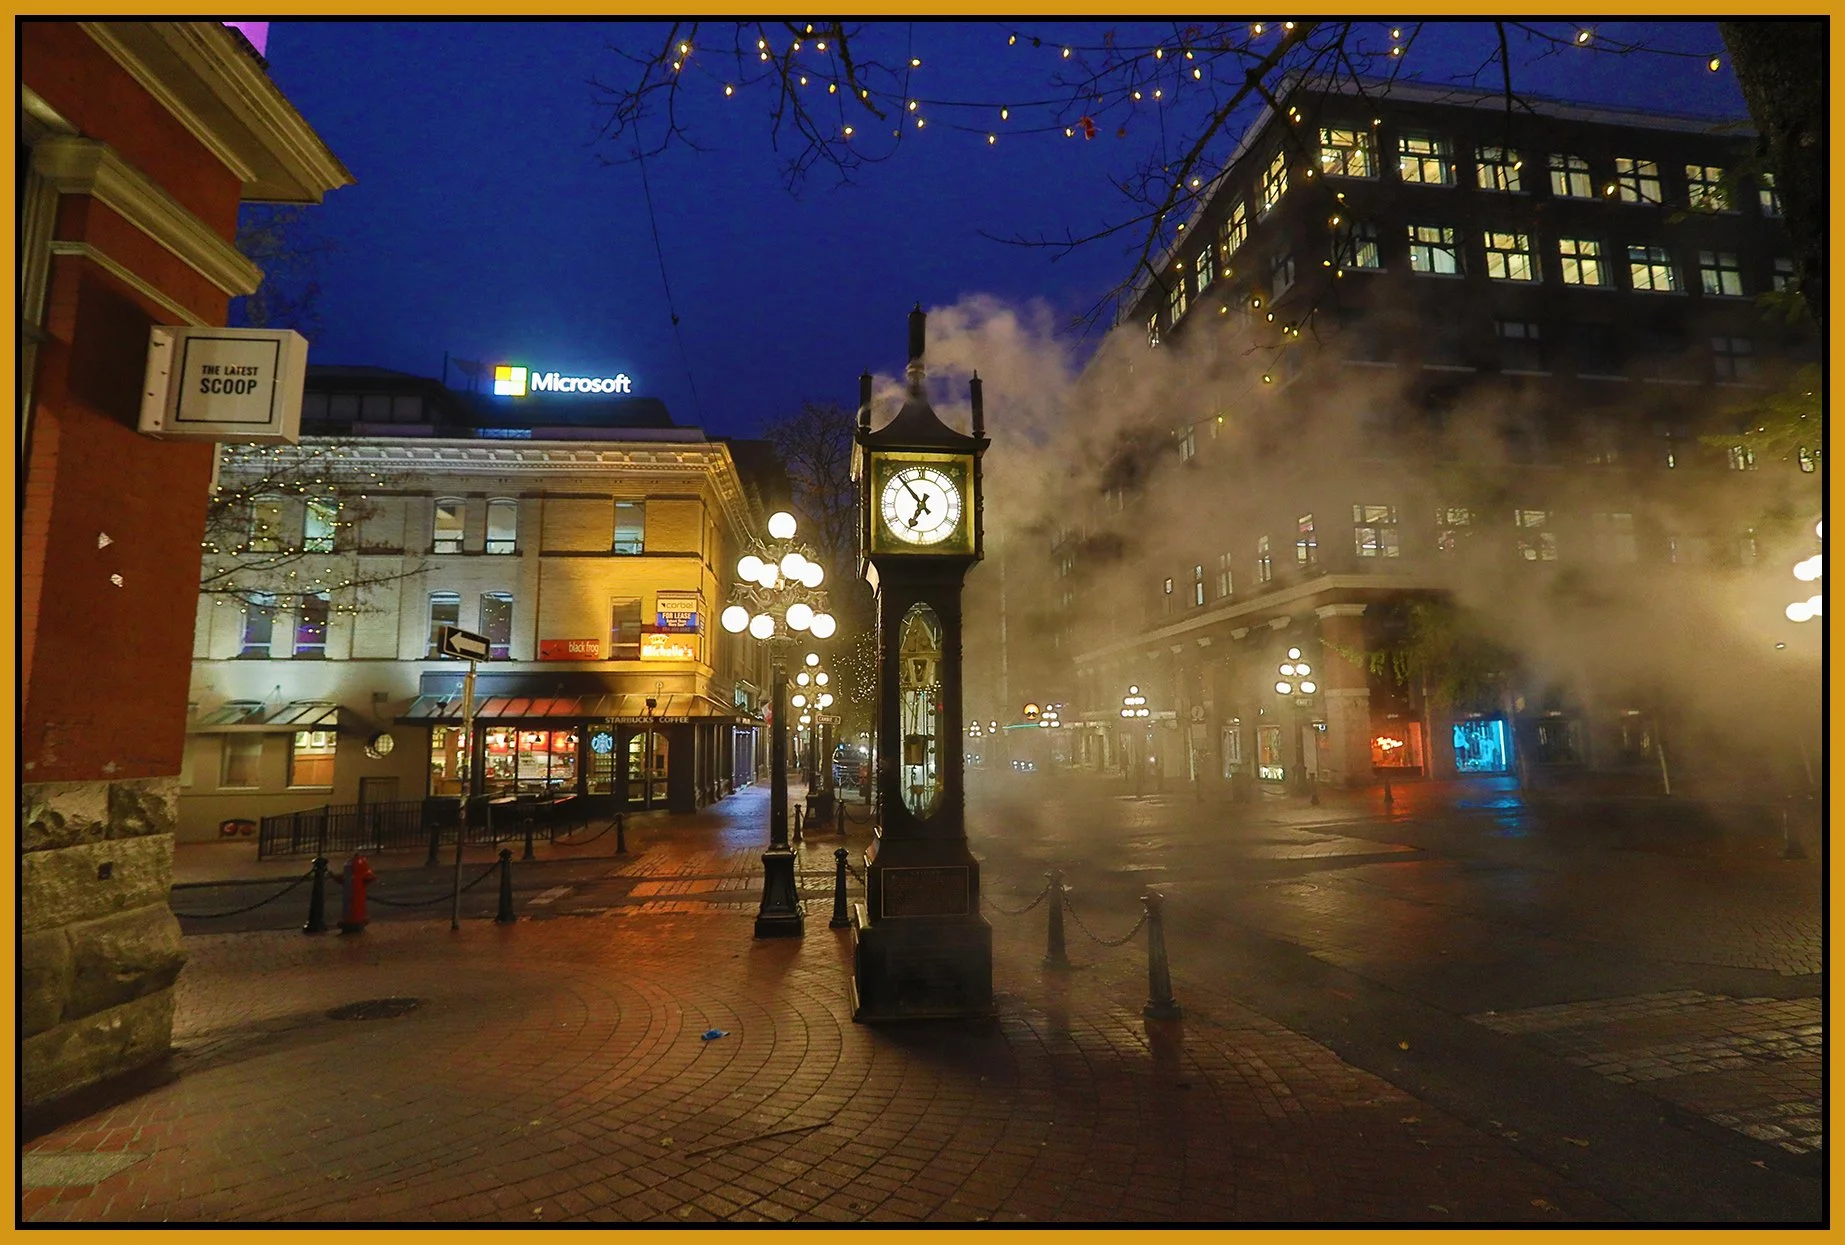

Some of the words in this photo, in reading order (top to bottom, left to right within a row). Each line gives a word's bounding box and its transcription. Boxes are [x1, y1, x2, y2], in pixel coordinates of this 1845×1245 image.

[202, 365, 220, 375] THE
[224, 366, 259, 376] LATEST
[200, 378, 258, 395] SCOOP
[531, 372, 632, 394] Microsoft
[568, 641, 585, 653] black
[586, 641, 599, 656] frog
